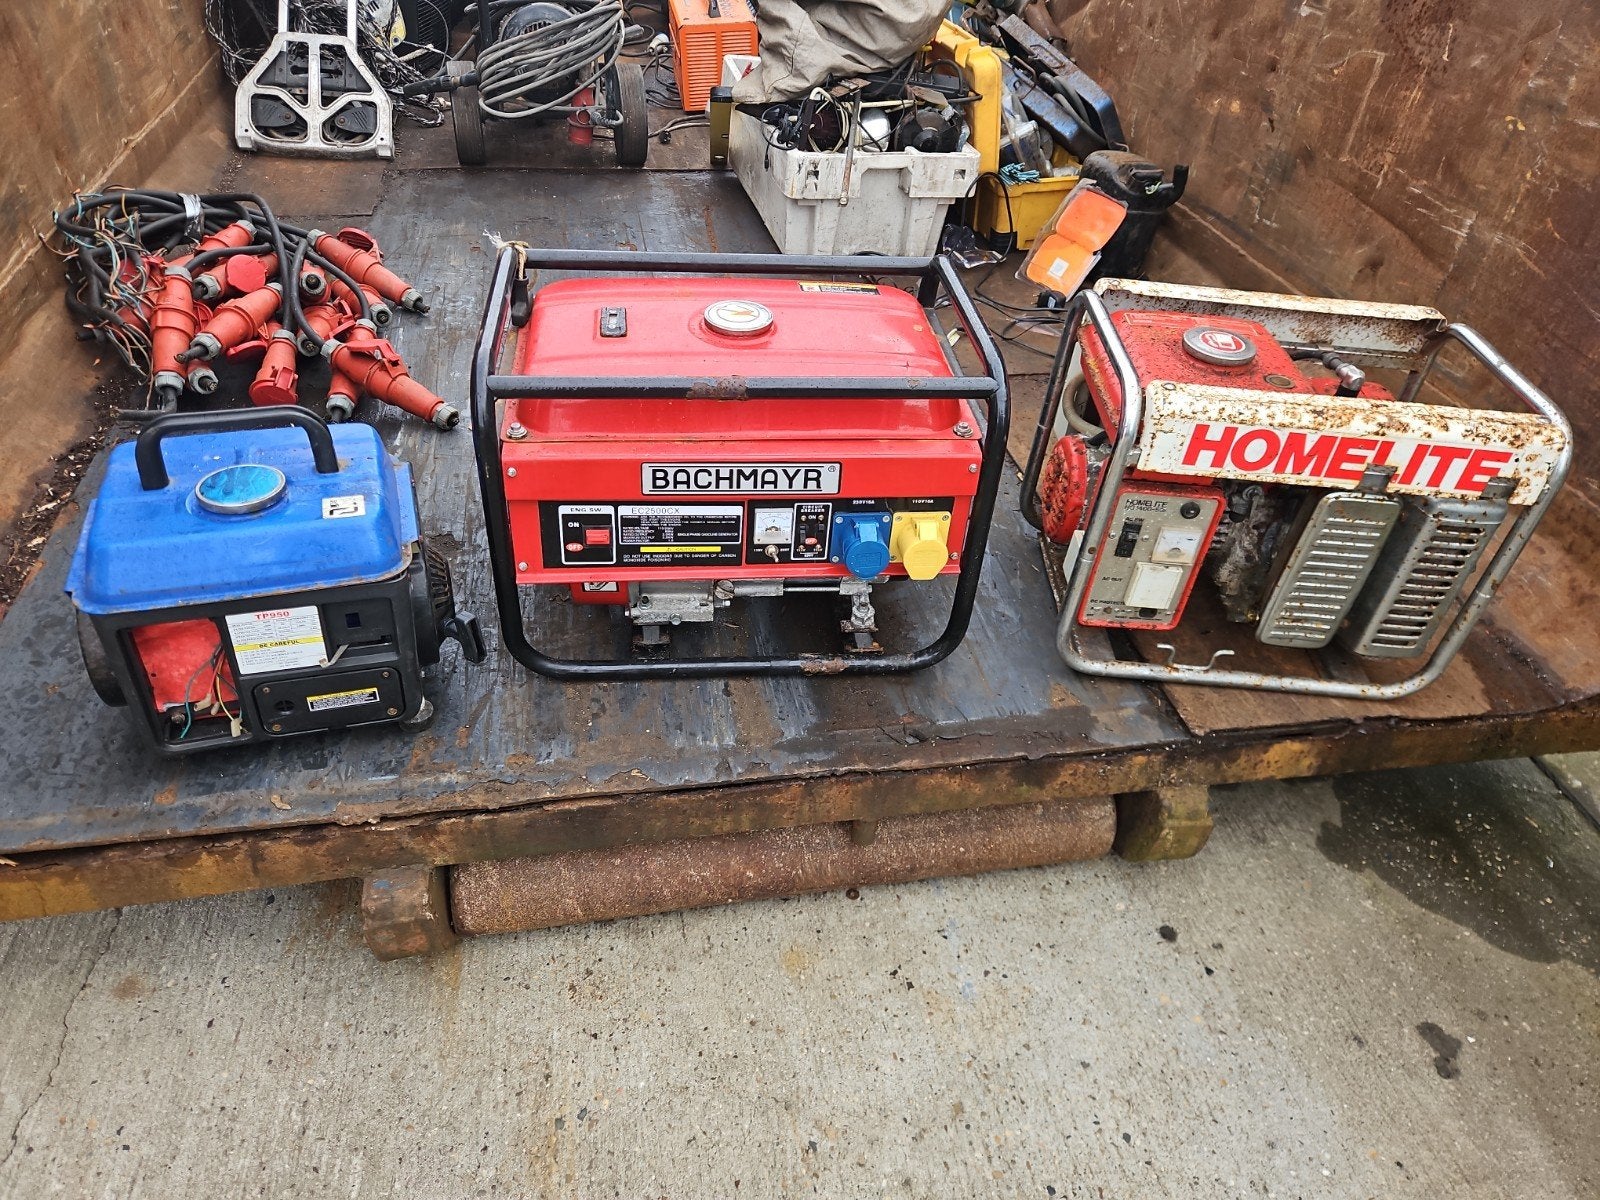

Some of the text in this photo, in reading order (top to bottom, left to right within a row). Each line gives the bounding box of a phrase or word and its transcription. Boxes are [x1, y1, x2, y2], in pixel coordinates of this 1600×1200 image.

[1181, 423, 1515, 492] HOMELITE
[651, 468, 822, 489] BACHMAYR
[1126, 499, 1168, 507] HOMELITE
[631, 507, 680, 515] EC2500CX
[254, 611, 290, 620] TP950
[270, 640, 300, 648] CAREFUL
